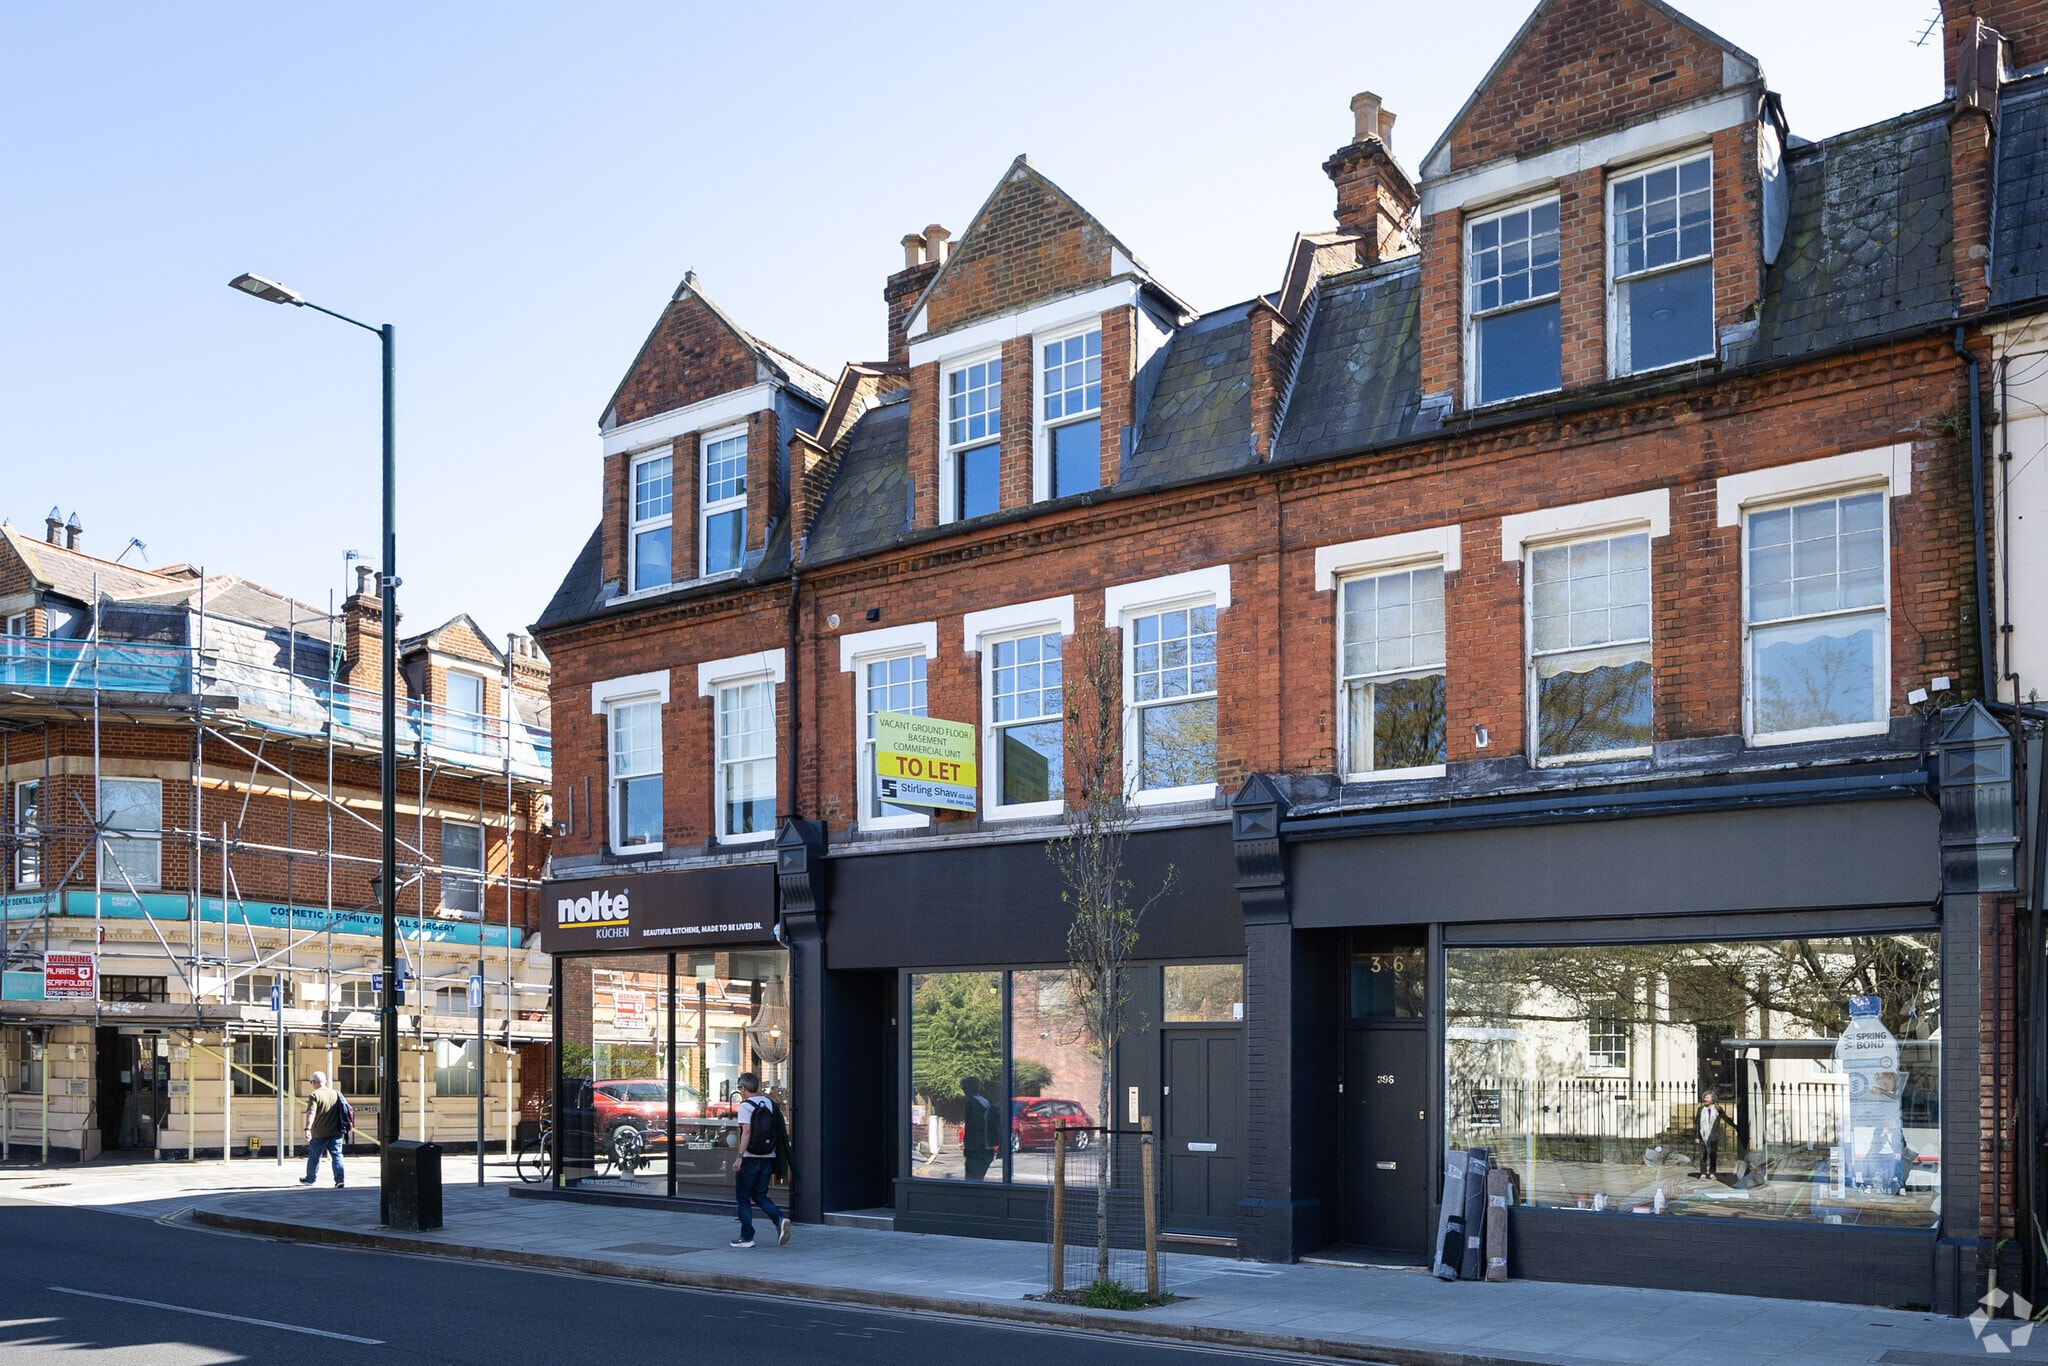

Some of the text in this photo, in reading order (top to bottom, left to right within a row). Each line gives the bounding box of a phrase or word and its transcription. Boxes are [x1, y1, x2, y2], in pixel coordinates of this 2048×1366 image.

[880, 719, 910, 730] VACANT
[912, 724, 944, 735] GROUND
[908, 733, 947, 746] BASEMENT
[893, 742, 961, 759] COMMERCIAL UNIT
[896, 756, 961, 781] TO LET
[901, 783, 932, 797] Stirling
[12, 897, 31, 906] DENTAL
[558, 890, 629, 922] nolte
[596, 927, 629, 939] KÜCHEN
[643, 929, 672, 937] BEAUTIFUL
[672, 927, 701, 935] KITCHENS,
[736, 923, 753, 931] LIVED
[48, 955, 92, 963] WARNING
[47, 967, 76, 975] ALARMS
[47, 979, 93, 987] SCAFFOLDING
[1856, 1032, 1887, 1040] SPRING
[1856, 1040, 1885, 1049] BOND
[1377, 1074, 1395, 1085] 396
[251, 1138, 260, 1148] H
